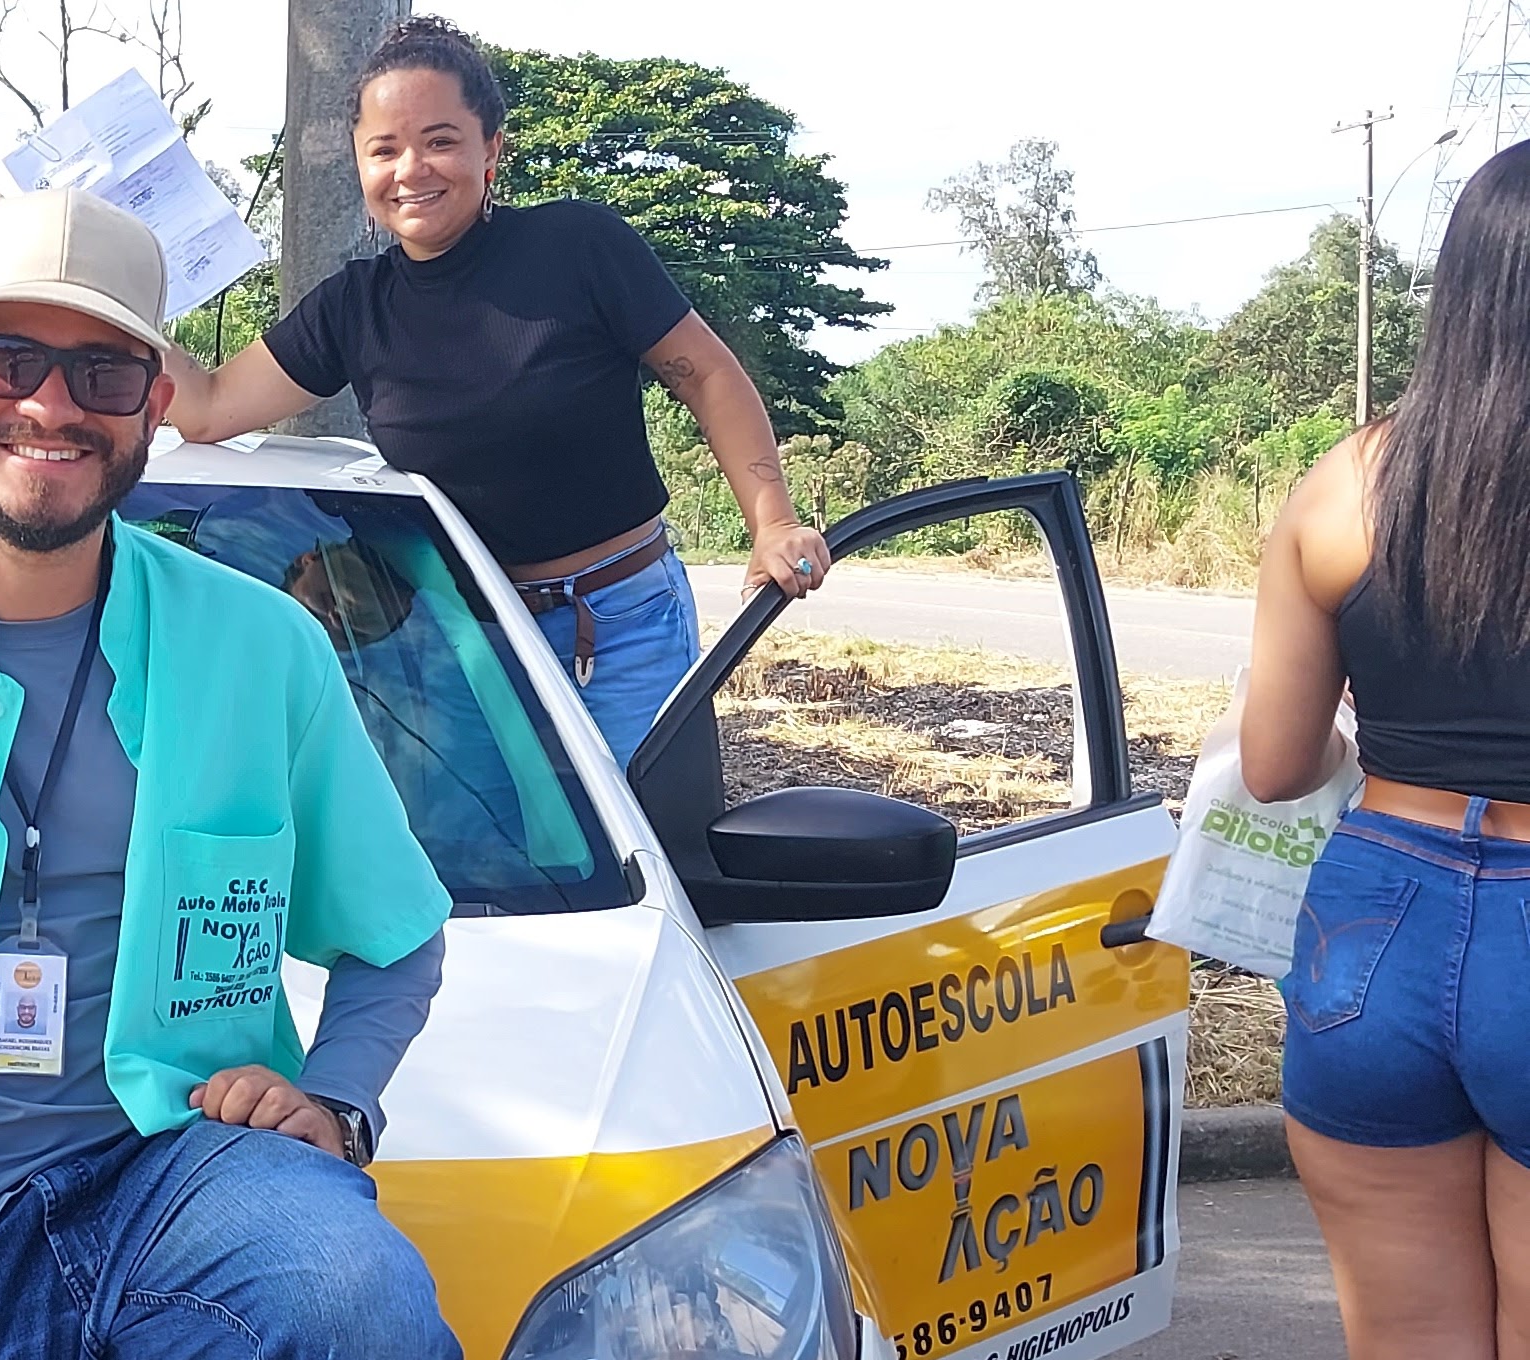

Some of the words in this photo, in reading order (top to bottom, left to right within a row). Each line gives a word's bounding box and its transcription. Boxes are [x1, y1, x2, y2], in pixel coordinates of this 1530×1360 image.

[177, 895, 216, 911] Auto
[220, 896, 261, 913] Moto
[201, 917, 261, 940] NOVA
[169, 985, 274, 1019] INSTRUTOR
[786, 942, 1077, 1094] AUTOESCOLA
[848, 1093, 1030, 1212] NOVA
[937, 1163, 1104, 1284] AÇÃO
